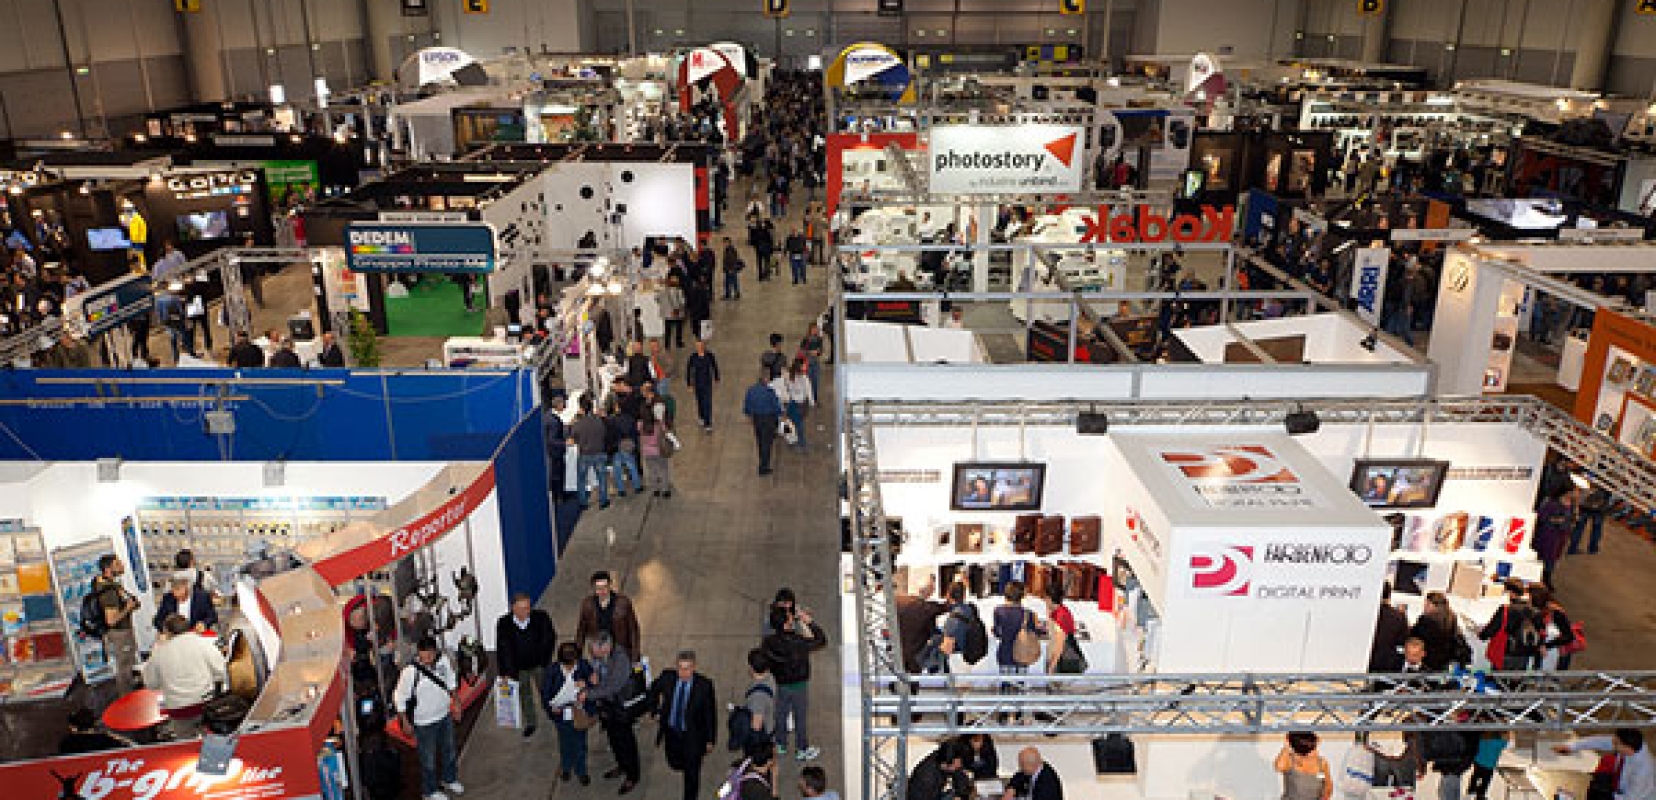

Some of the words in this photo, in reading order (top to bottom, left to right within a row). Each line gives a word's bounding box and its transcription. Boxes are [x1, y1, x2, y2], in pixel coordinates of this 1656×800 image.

[422, 52, 459, 63] EPSON
[935, 149, 1046, 173] photostory
[350, 231, 410, 245] DEDEM
[1358, 267, 1380, 312] ARRI
[389, 496, 469, 557] Reporter
[1264, 543, 1372, 565] FARBENFOTO
[1258, 585, 1316, 599] DIGITAL
[1319, 585, 1362, 599] PRINT
[106, 758, 144, 775] The
